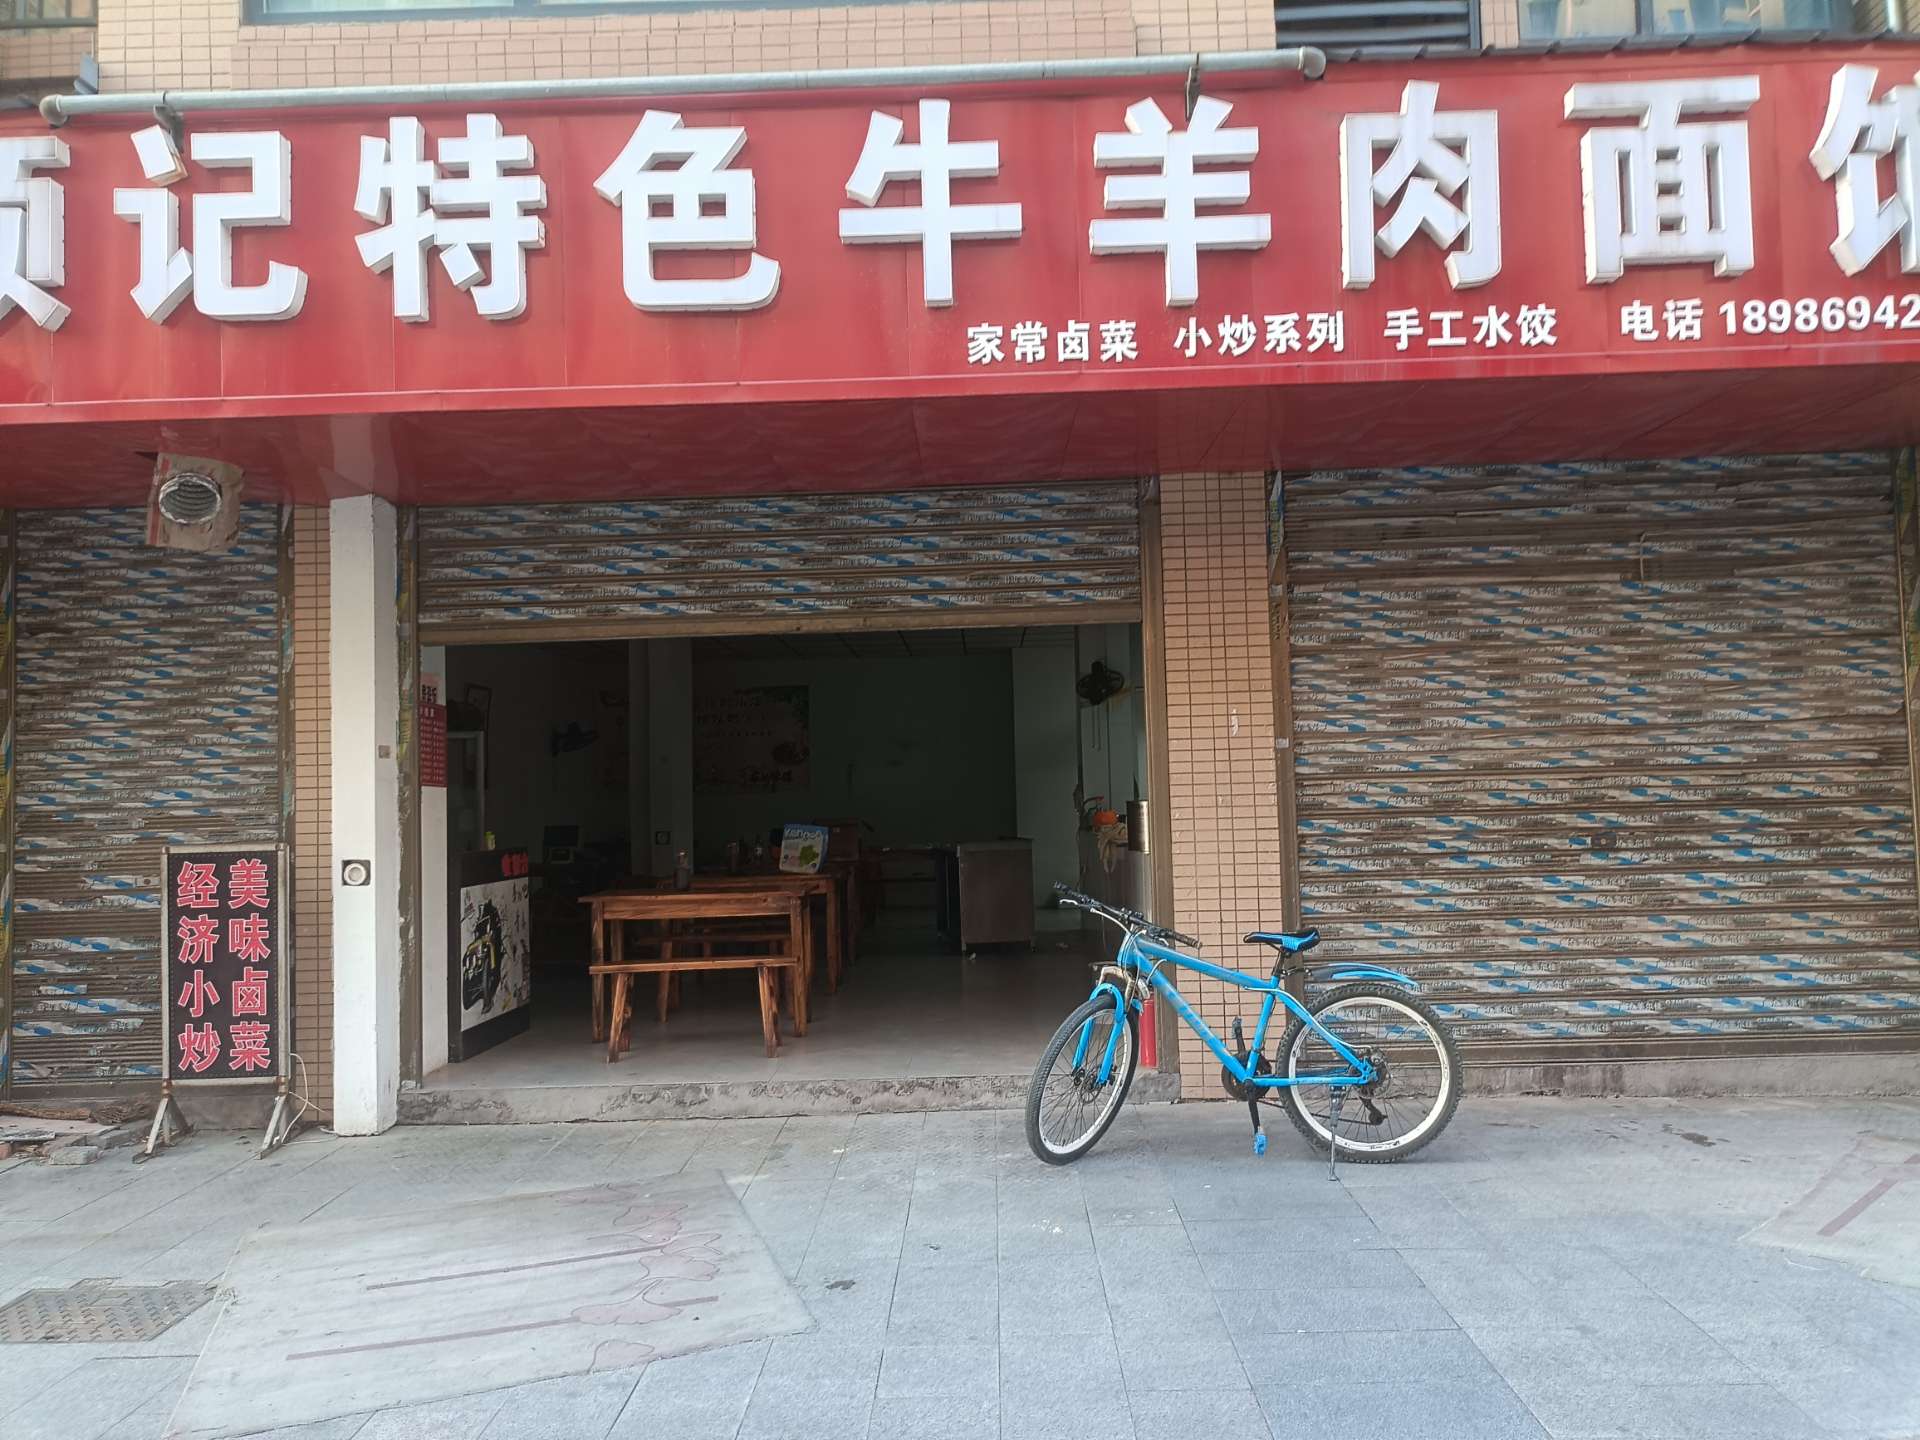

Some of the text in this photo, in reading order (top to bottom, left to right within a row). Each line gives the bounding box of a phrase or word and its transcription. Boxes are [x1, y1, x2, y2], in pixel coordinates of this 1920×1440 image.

[967, 294, 1920, 364] 家常卤菜 小炒系列 手工水饺 电话 18986942
[177, 861, 221, 1073] 经济小炒
[228, 858, 271, 1072] 美味卤菜
